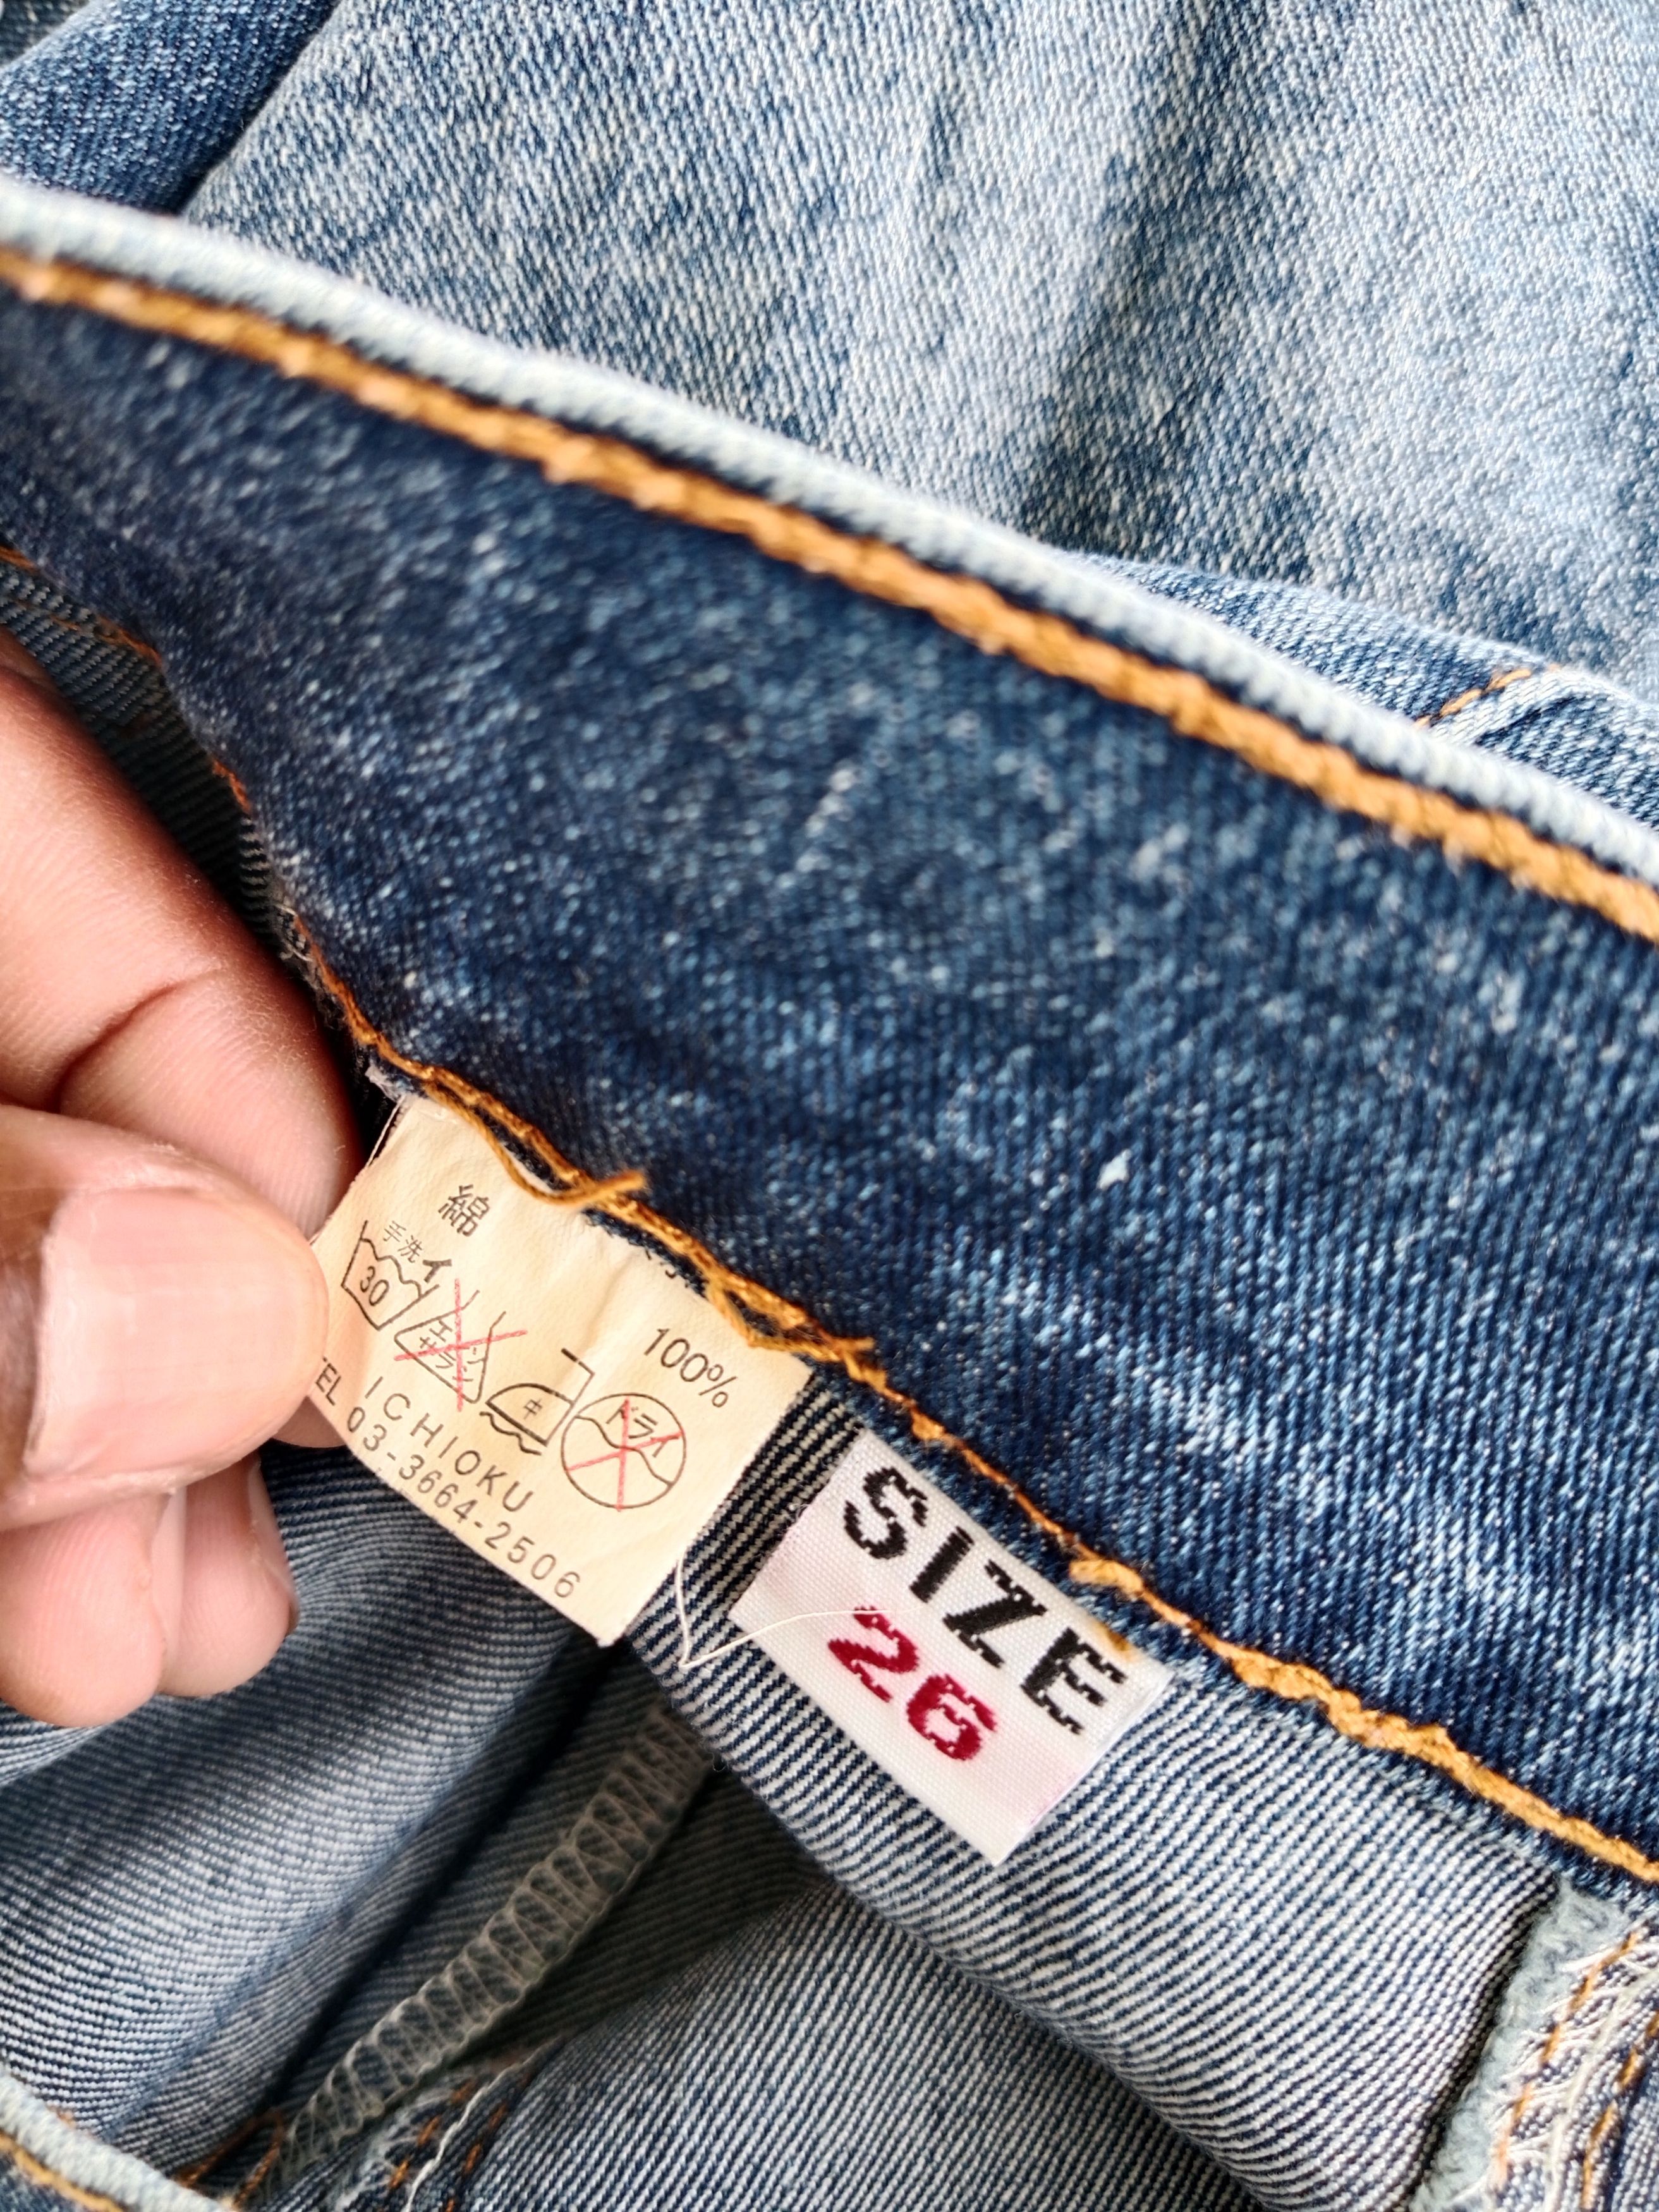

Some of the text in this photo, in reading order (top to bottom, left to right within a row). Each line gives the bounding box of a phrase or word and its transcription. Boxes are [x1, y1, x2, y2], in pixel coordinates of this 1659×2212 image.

[360, 1265, 390, 1307] 30
[382, 1220, 453, 1284] 手洗イ
[438, 1184, 738, 1408] 綿 100%
[315, 1356, 581, 1599] EL 03-3664-2506
[364, 1376, 535, 1512] ICHIOKU
[523, 1397, 543, 1419] 中
[843, 1466, 1129, 1736] SIZE
[828, 1605, 999, 1761] 26
